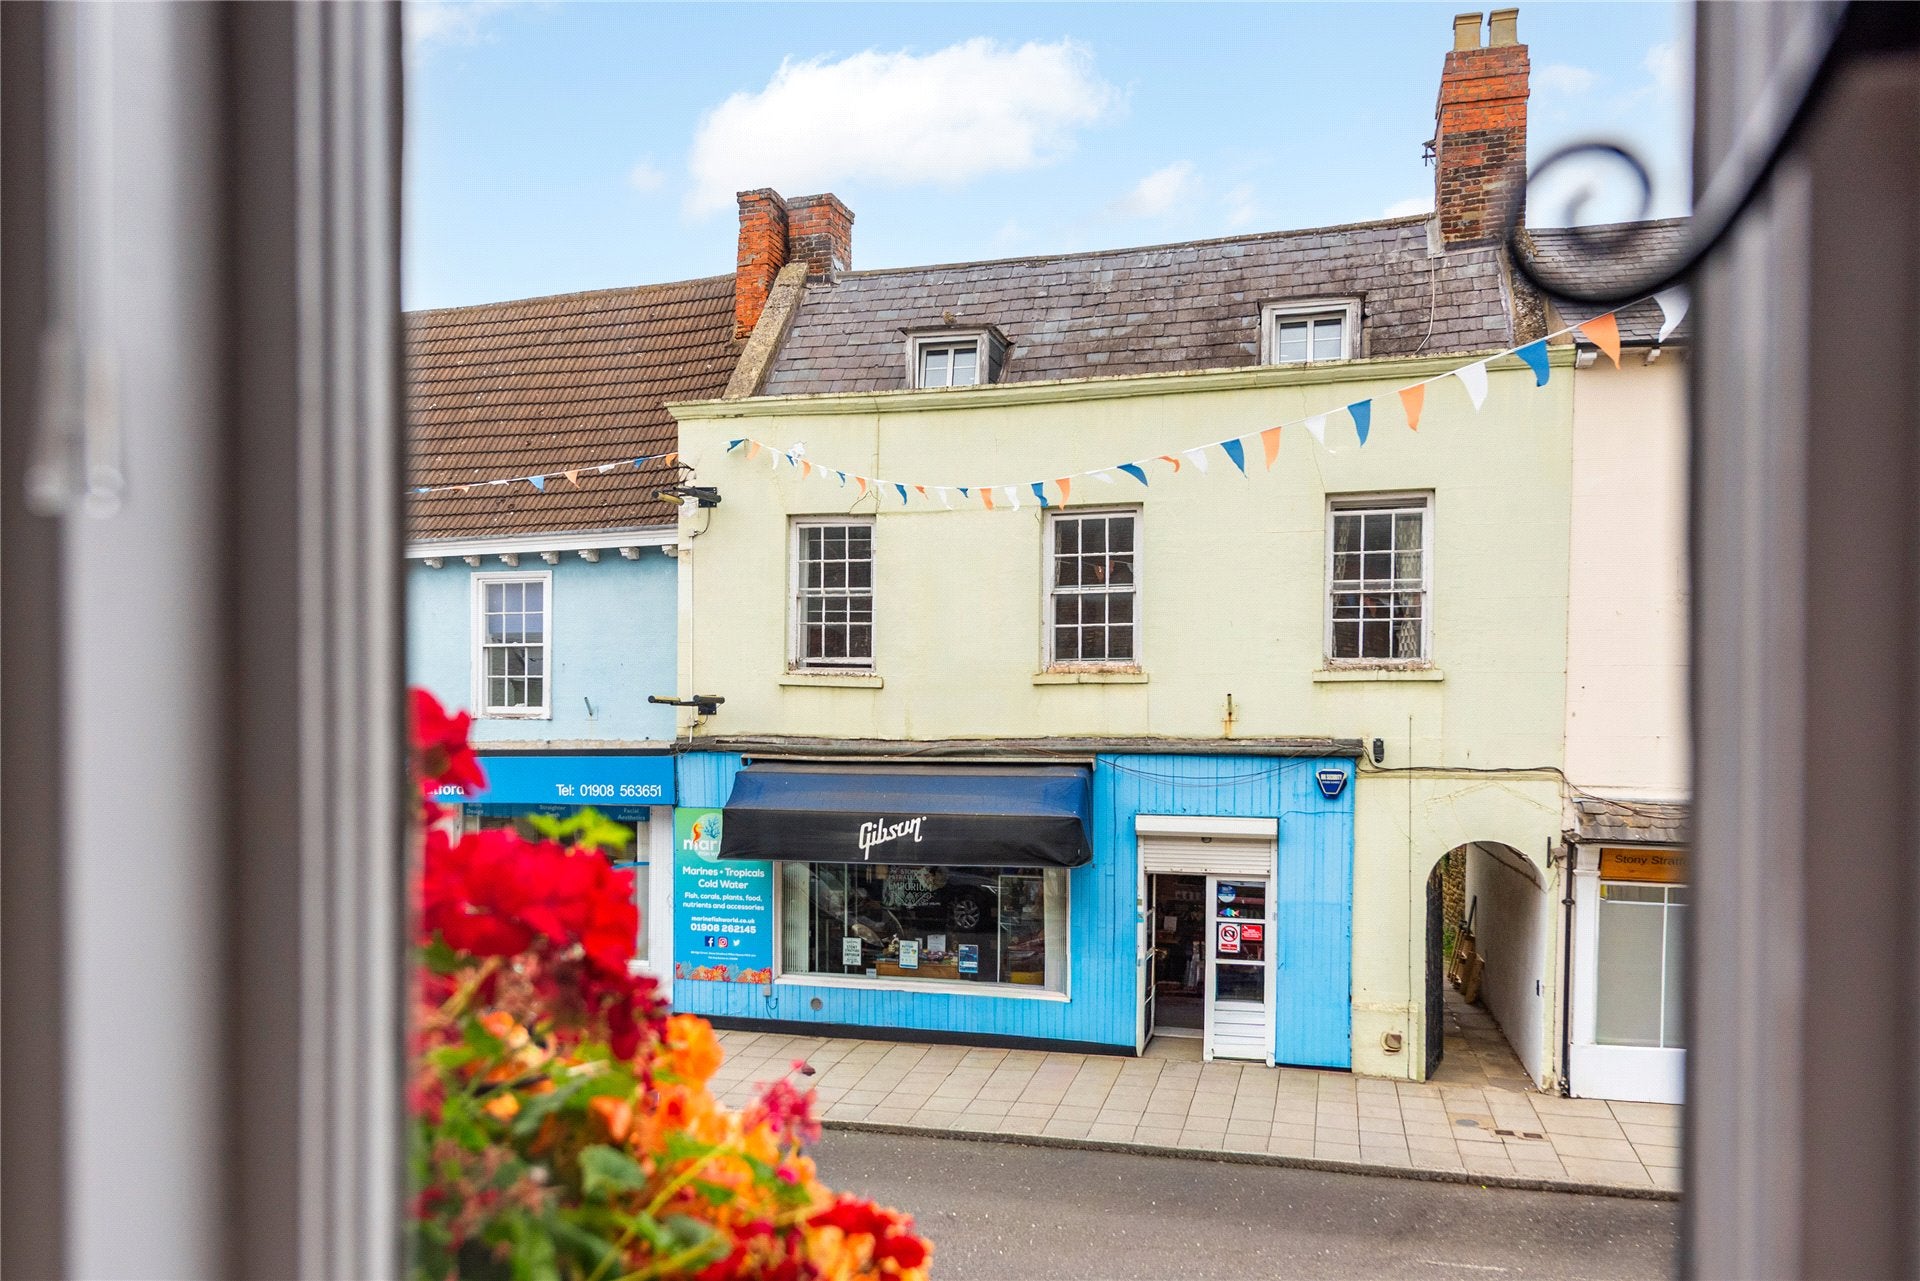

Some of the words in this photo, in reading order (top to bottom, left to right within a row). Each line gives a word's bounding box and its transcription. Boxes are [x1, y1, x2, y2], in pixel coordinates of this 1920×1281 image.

[556, 783, 575, 797] Tel:
[579, 784, 614, 797] 01908
[619, 784, 662, 797] 563651
[859, 817, 922, 860] Gibson
[683, 839, 718, 851] mar
[1615, 854, 1648, 866] Stony
[683, 866, 718, 876] Marines
[724, 867, 765, 878] Tropicals
[698, 879, 718, 888] Cold
[720, 880, 749, 889] Water
[722, 893, 744, 902] plants,
[745, 894, 762, 902] food,
[712, 902, 726, 910] and
[726, 903, 765, 911] accessories
[691, 923, 720, 931] 01908
[721, 924, 757, 934] 262145
